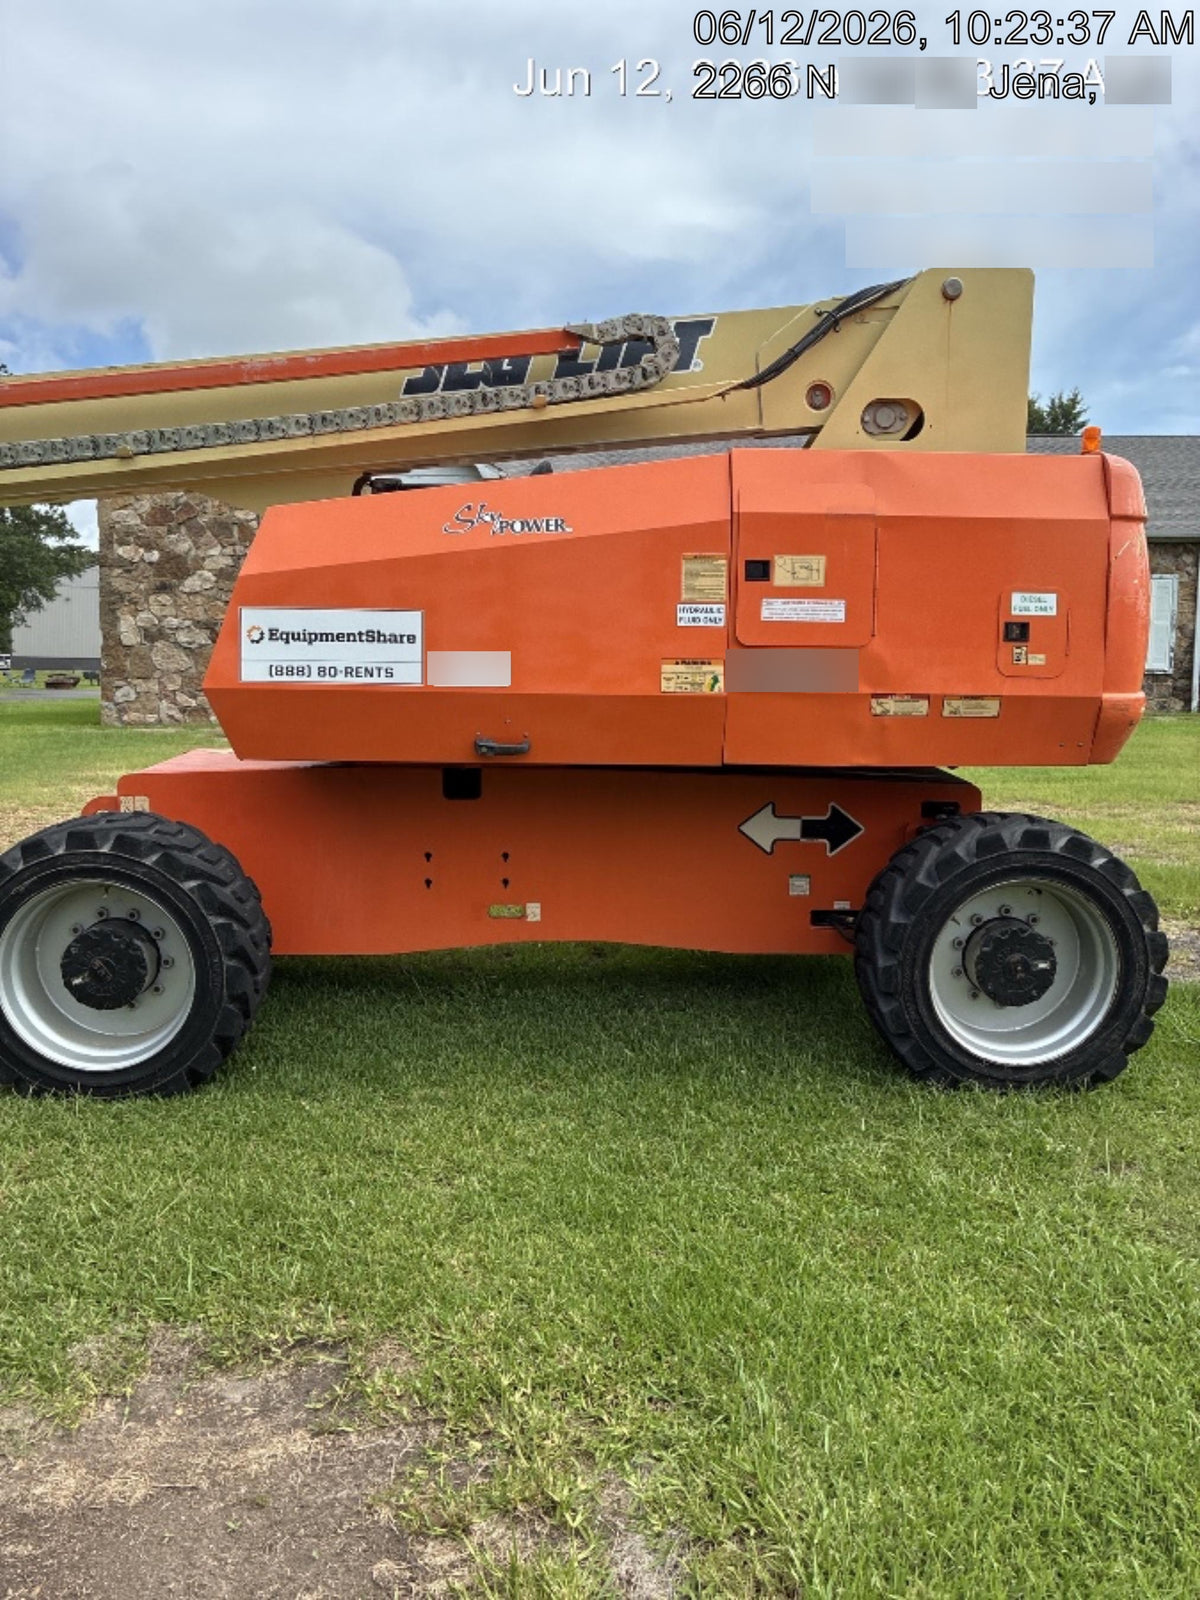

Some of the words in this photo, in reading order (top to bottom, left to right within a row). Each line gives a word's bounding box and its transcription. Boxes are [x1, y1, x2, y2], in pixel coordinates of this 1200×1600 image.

[442, 502, 502, 536] Sky
[499, 517, 573, 534] POWER
[678, 605, 725, 615] HYDRAULIC
[267, 627, 417, 646] EquipmentShare
[268, 664, 312, 678] (888)
